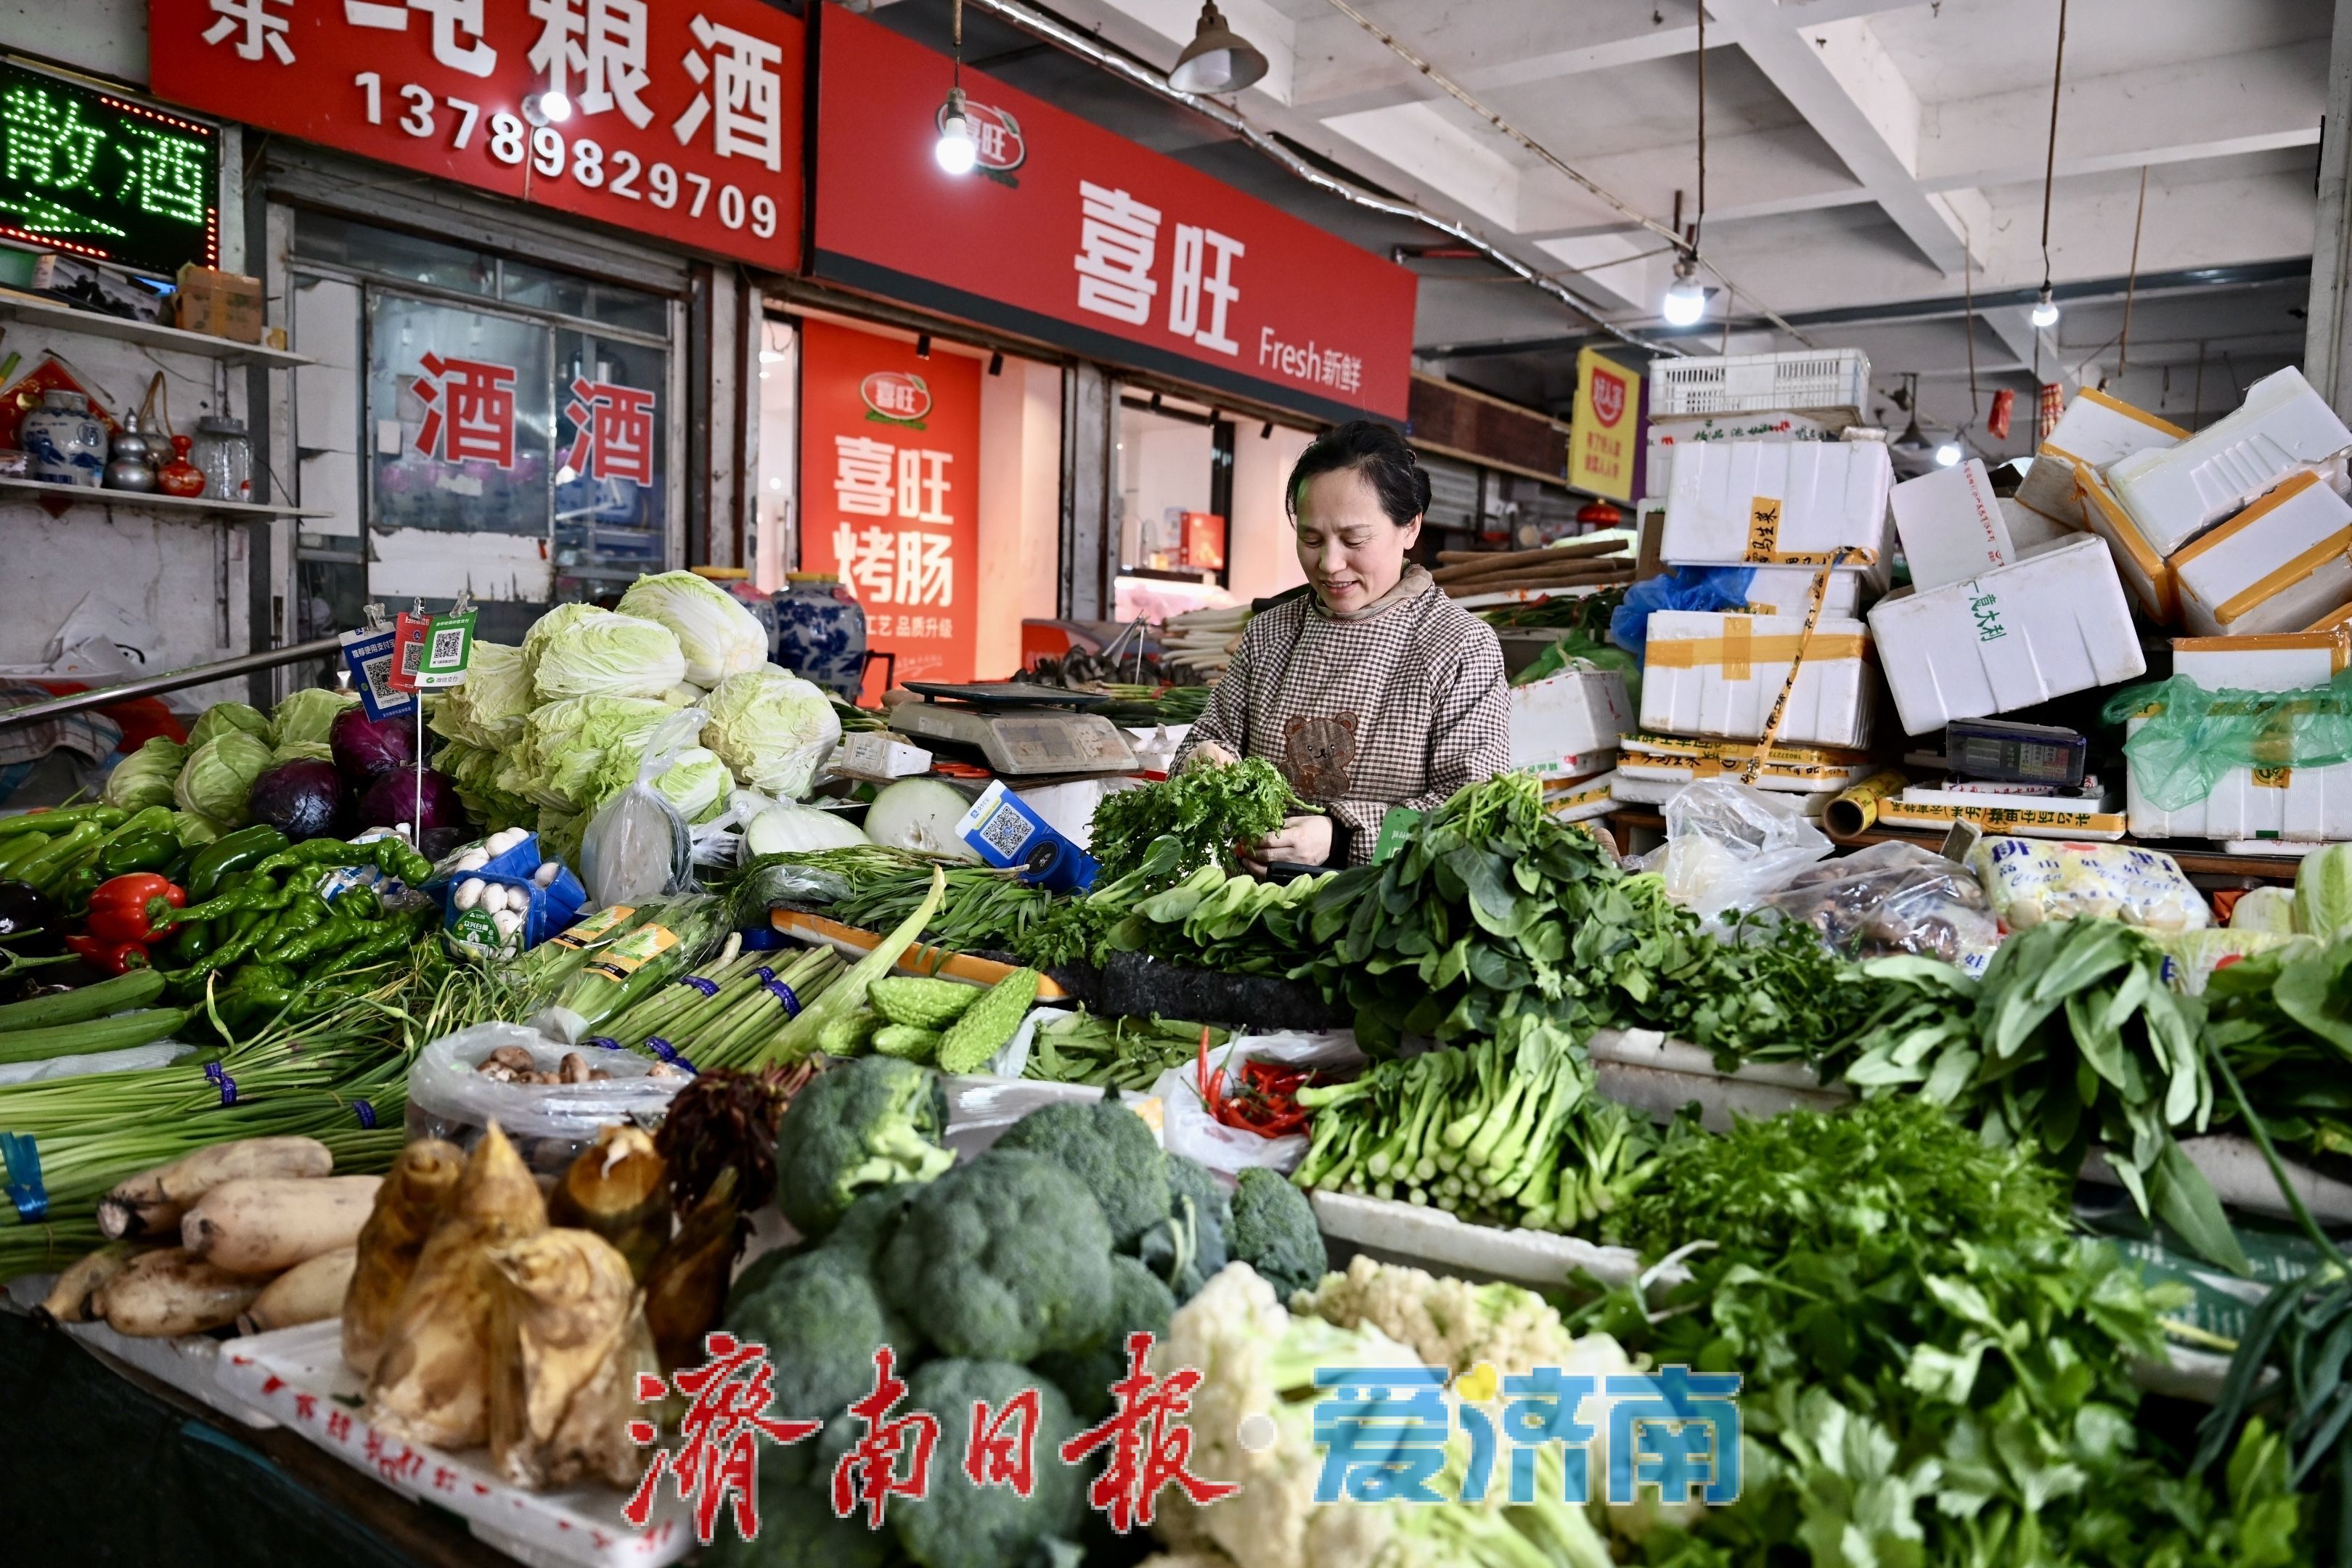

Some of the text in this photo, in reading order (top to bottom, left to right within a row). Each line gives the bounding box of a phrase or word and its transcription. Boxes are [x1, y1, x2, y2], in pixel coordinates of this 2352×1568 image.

[2, 84, 207, 226] 散酒
[355, 71, 777, 239] 13789829709
[1073, 179, 1245, 357] 喜旺
[875, 379, 916, 414] 喜旺
[1259, 326, 1362, 395] Fresh 新鲜
[410, 350, 517, 470] 酒
[564, 376, 656, 488] 酒
[833, 436, 954, 526] 喜旺
[833, 522, 953, 608] 烤肠
[895, 615, 953, 639] 品质升级
[976, 796, 991, 812] 支付宝
